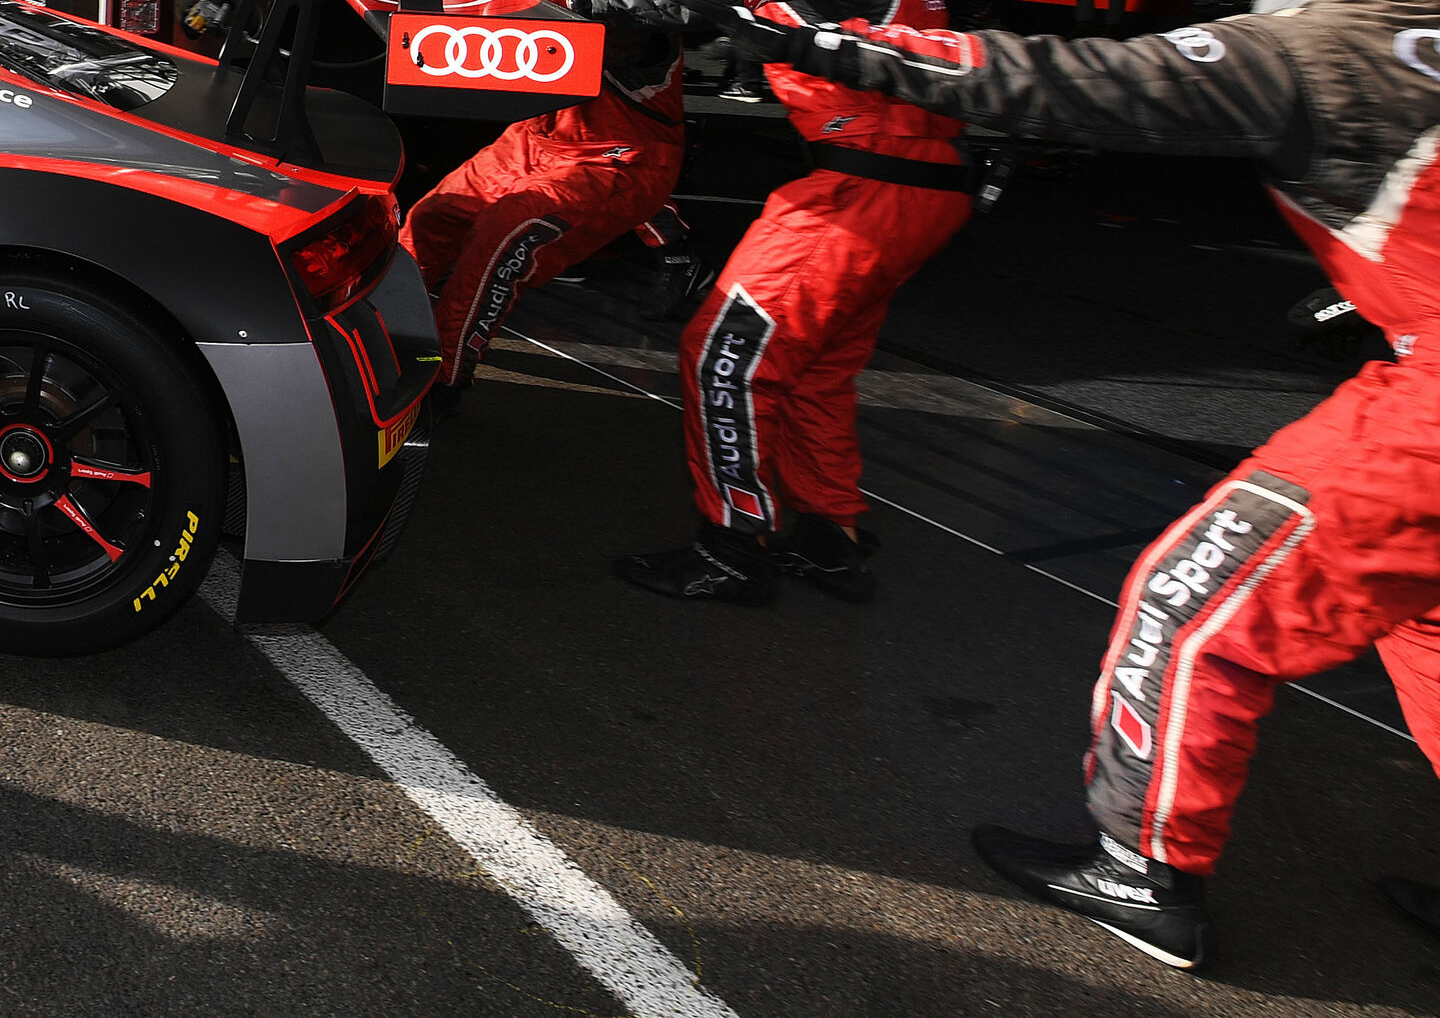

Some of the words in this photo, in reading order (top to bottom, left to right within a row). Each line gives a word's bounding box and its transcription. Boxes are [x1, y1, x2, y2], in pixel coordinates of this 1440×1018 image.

[4, 291, 31, 310] RL
[478, 283, 510, 332] Audi
[497, 234, 540, 280] Sport
[712, 332, 746, 410] Sport
[712, 416, 742, 481] Audi
[133, 510, 199, 613] PIRELLI
[1114, 599, 1170, 702] Audi
[1147, 509, 1253, 607] Sport
[1097, 879, 1159, 904] uvex
